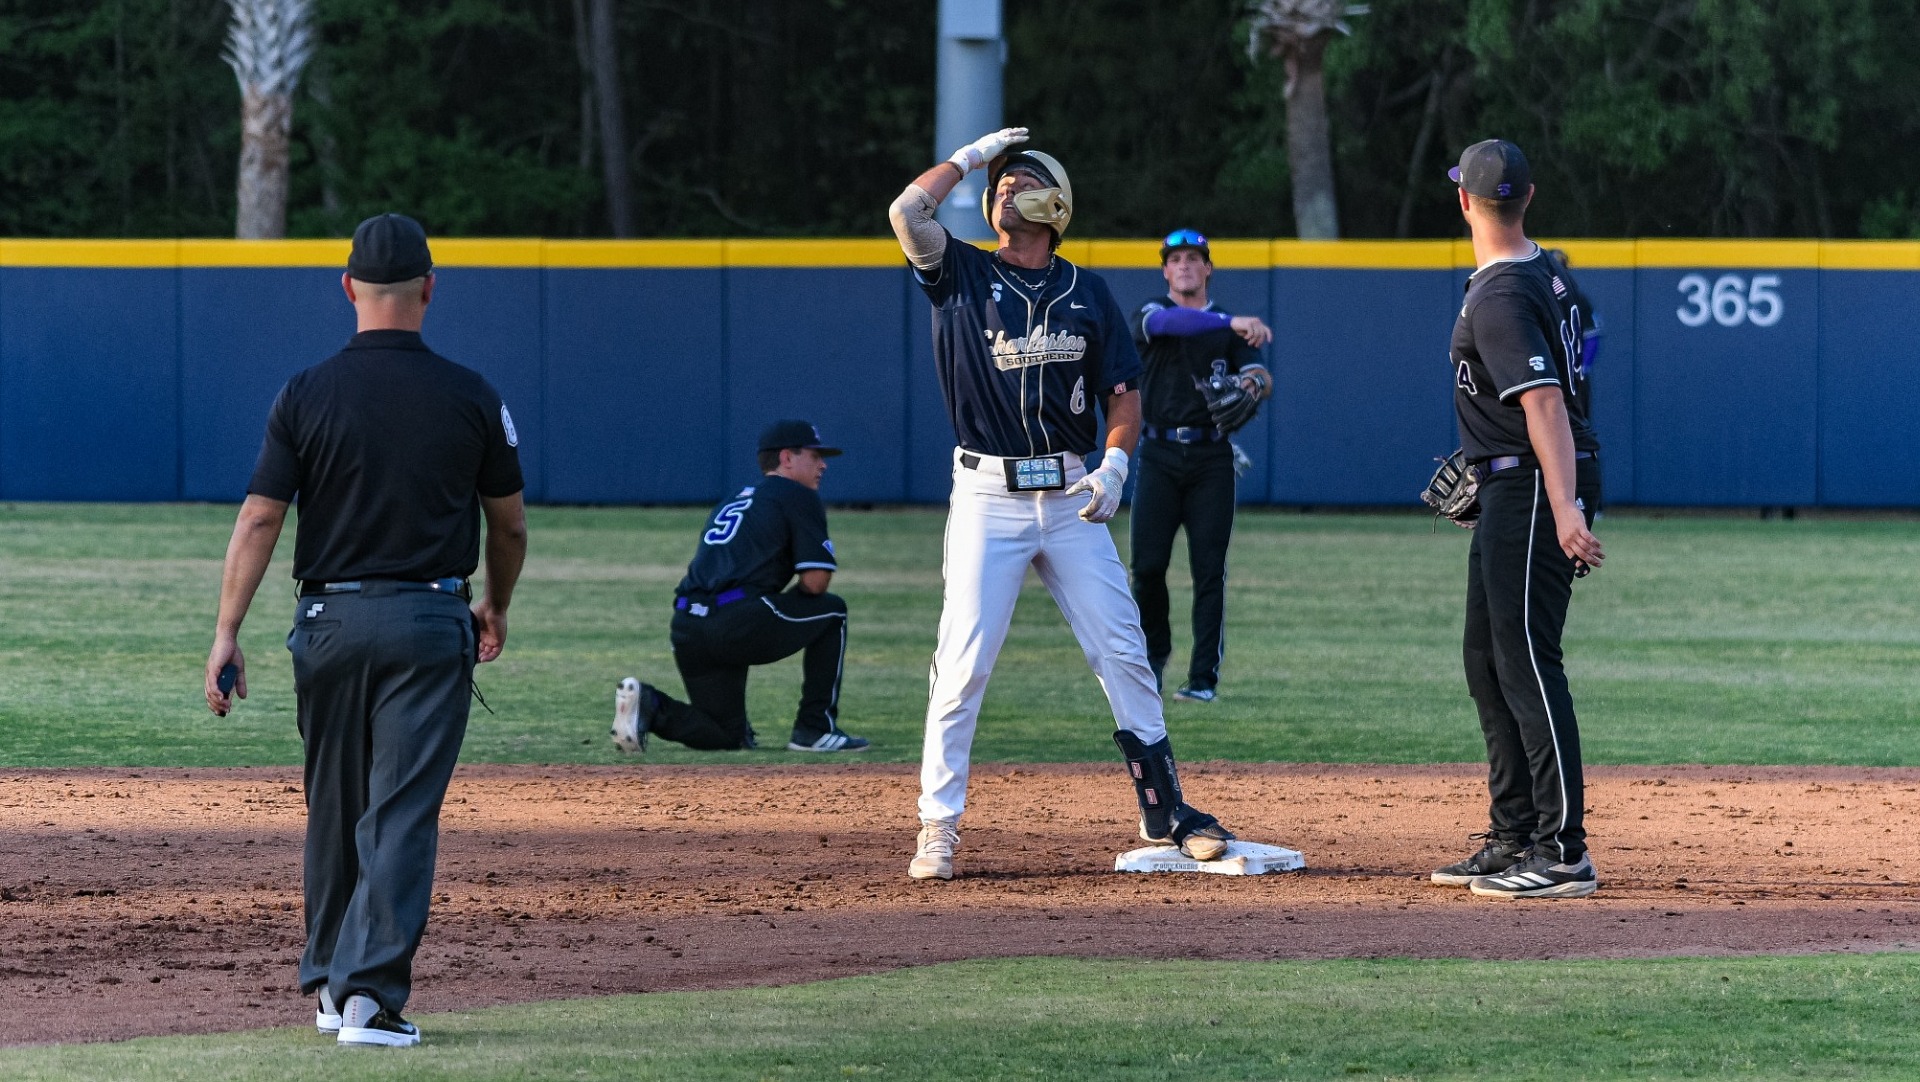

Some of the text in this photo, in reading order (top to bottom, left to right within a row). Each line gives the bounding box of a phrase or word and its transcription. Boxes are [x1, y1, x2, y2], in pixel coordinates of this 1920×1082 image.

[1676, 275, 1784, 327] 365
[1006, 353, 1075, 367] SOUTHERN
[1070, 375, 1086, 415] 6
[704, 498, 753, 545] 5
